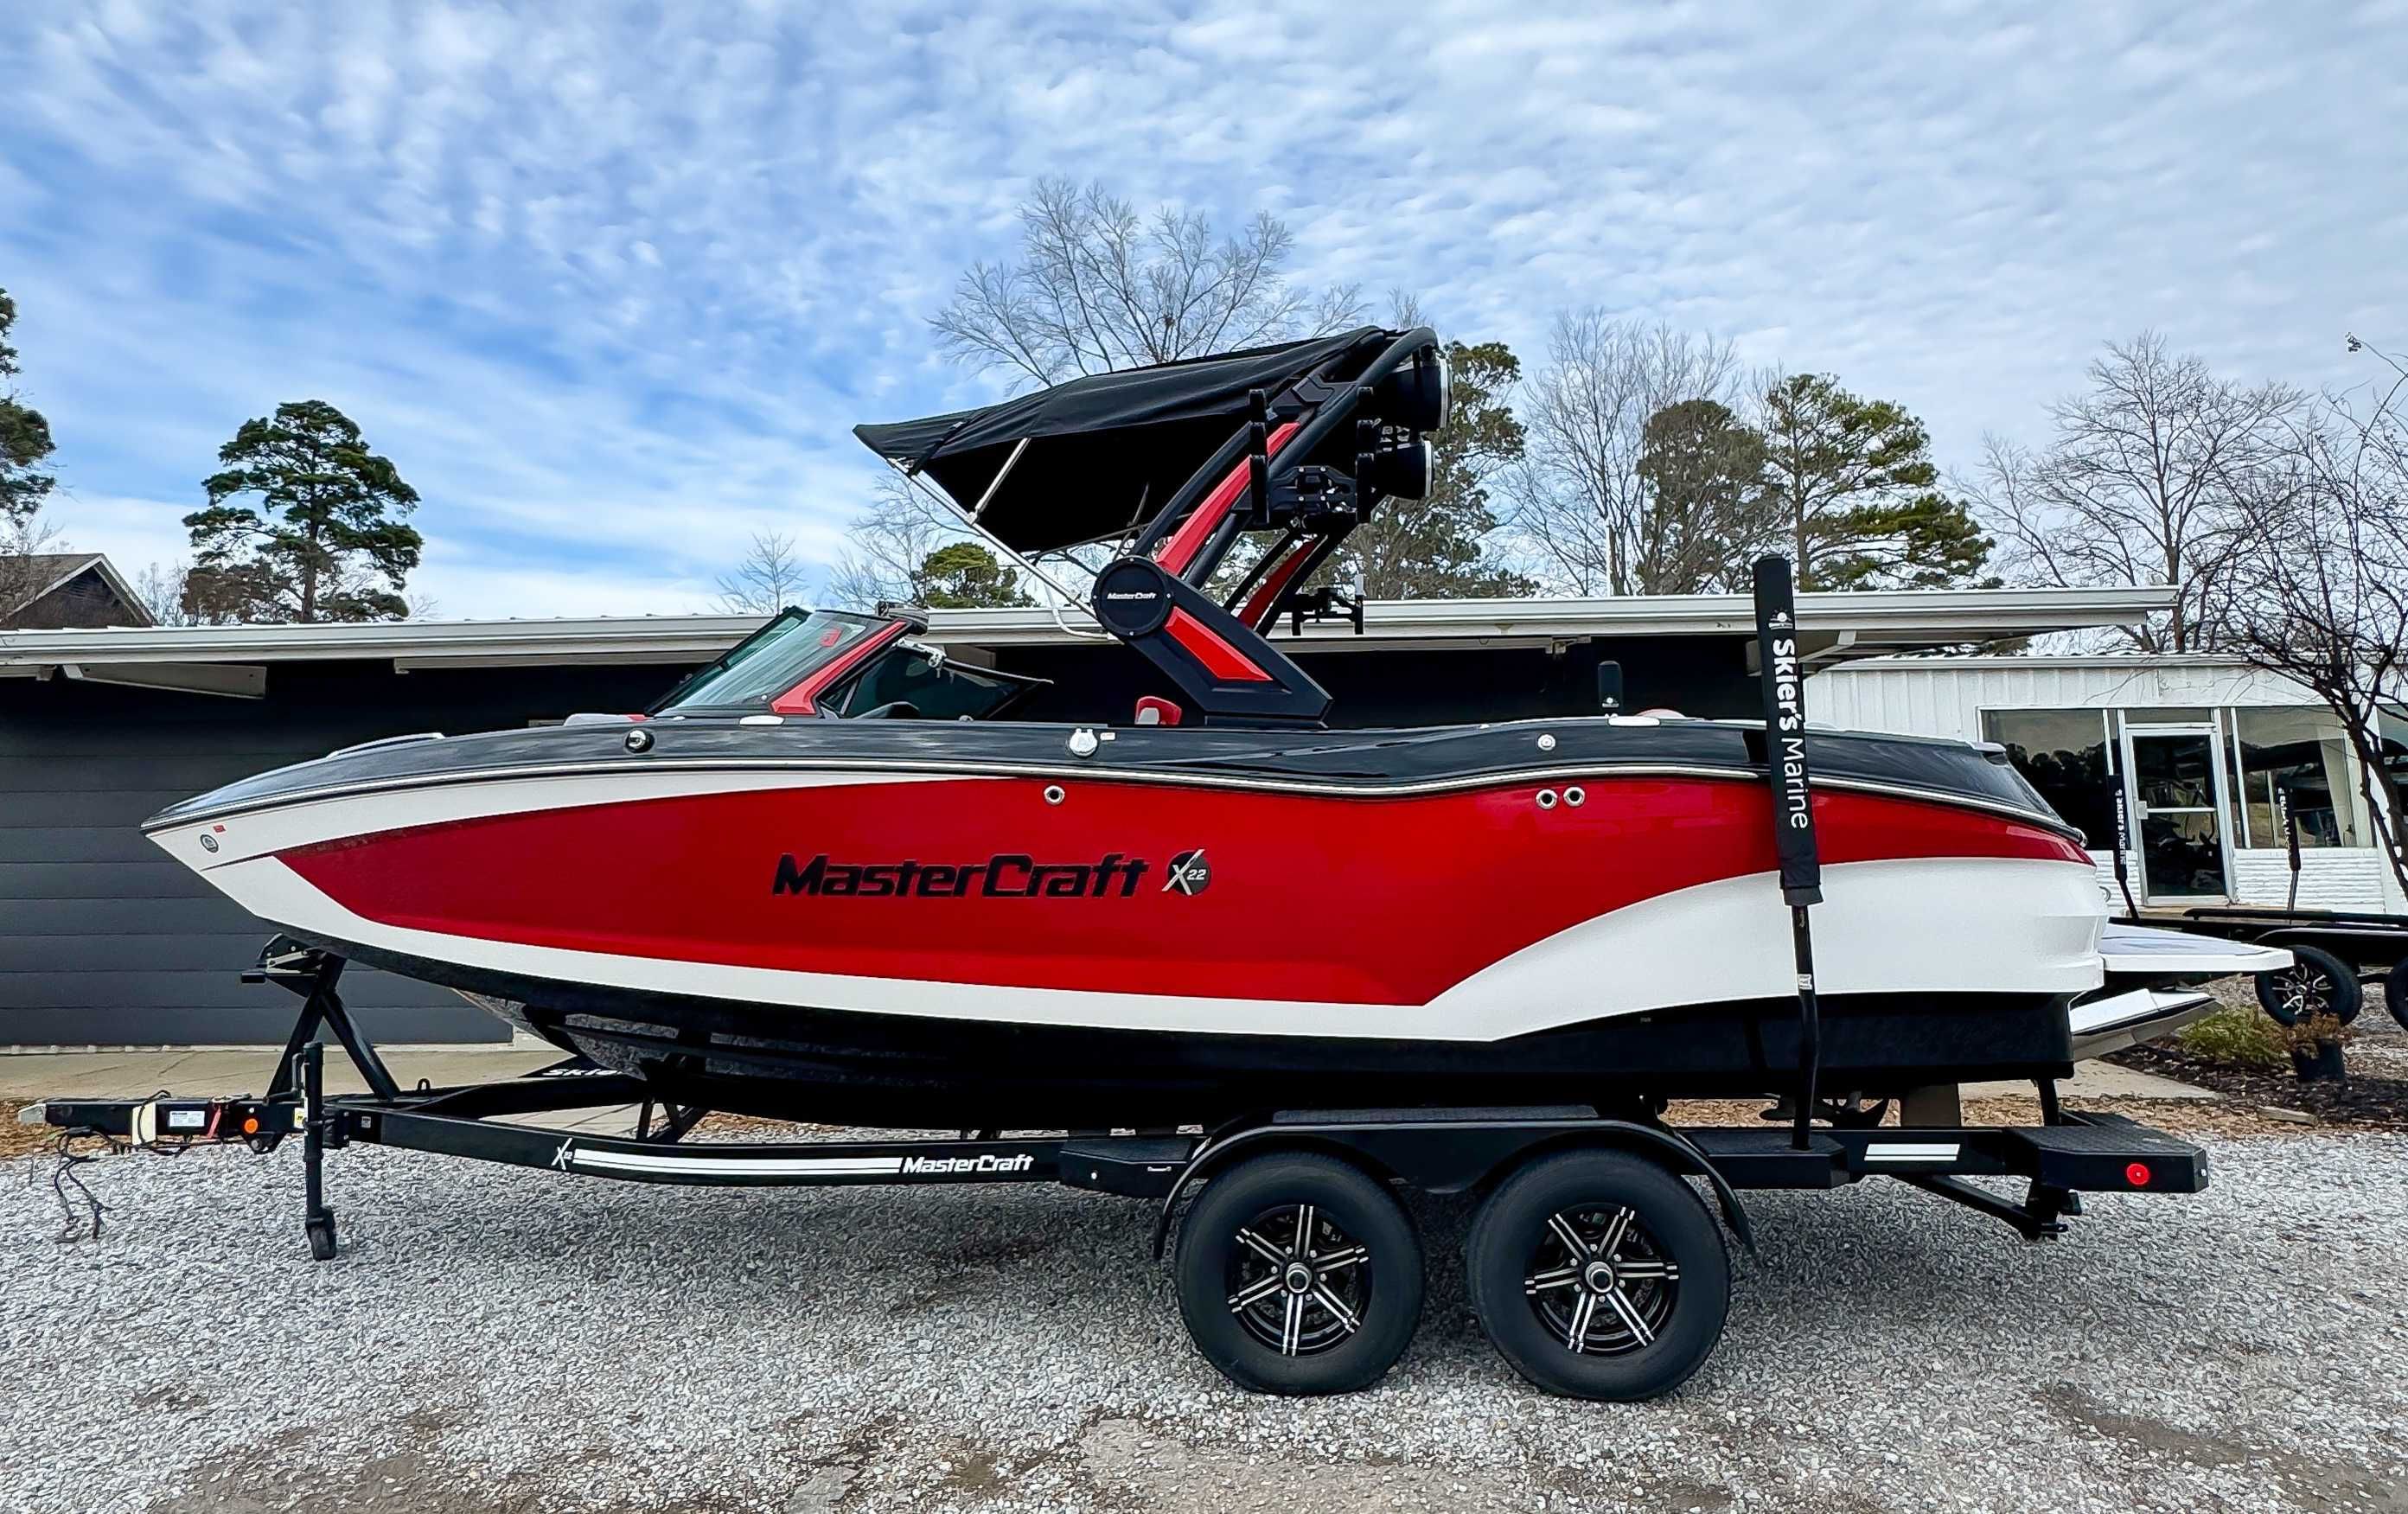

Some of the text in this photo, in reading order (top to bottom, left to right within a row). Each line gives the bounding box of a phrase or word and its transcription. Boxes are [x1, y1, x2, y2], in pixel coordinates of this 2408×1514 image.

[1107, 591, 1157, 600] MasterCraft
[1772, 638, 1803, 731] Skier's
[1781, 738, 1809, 828] Marine
[773, 853, 1151, 898] MasterCraft
[903, 1153, 1034, 1173] MasterCraft
